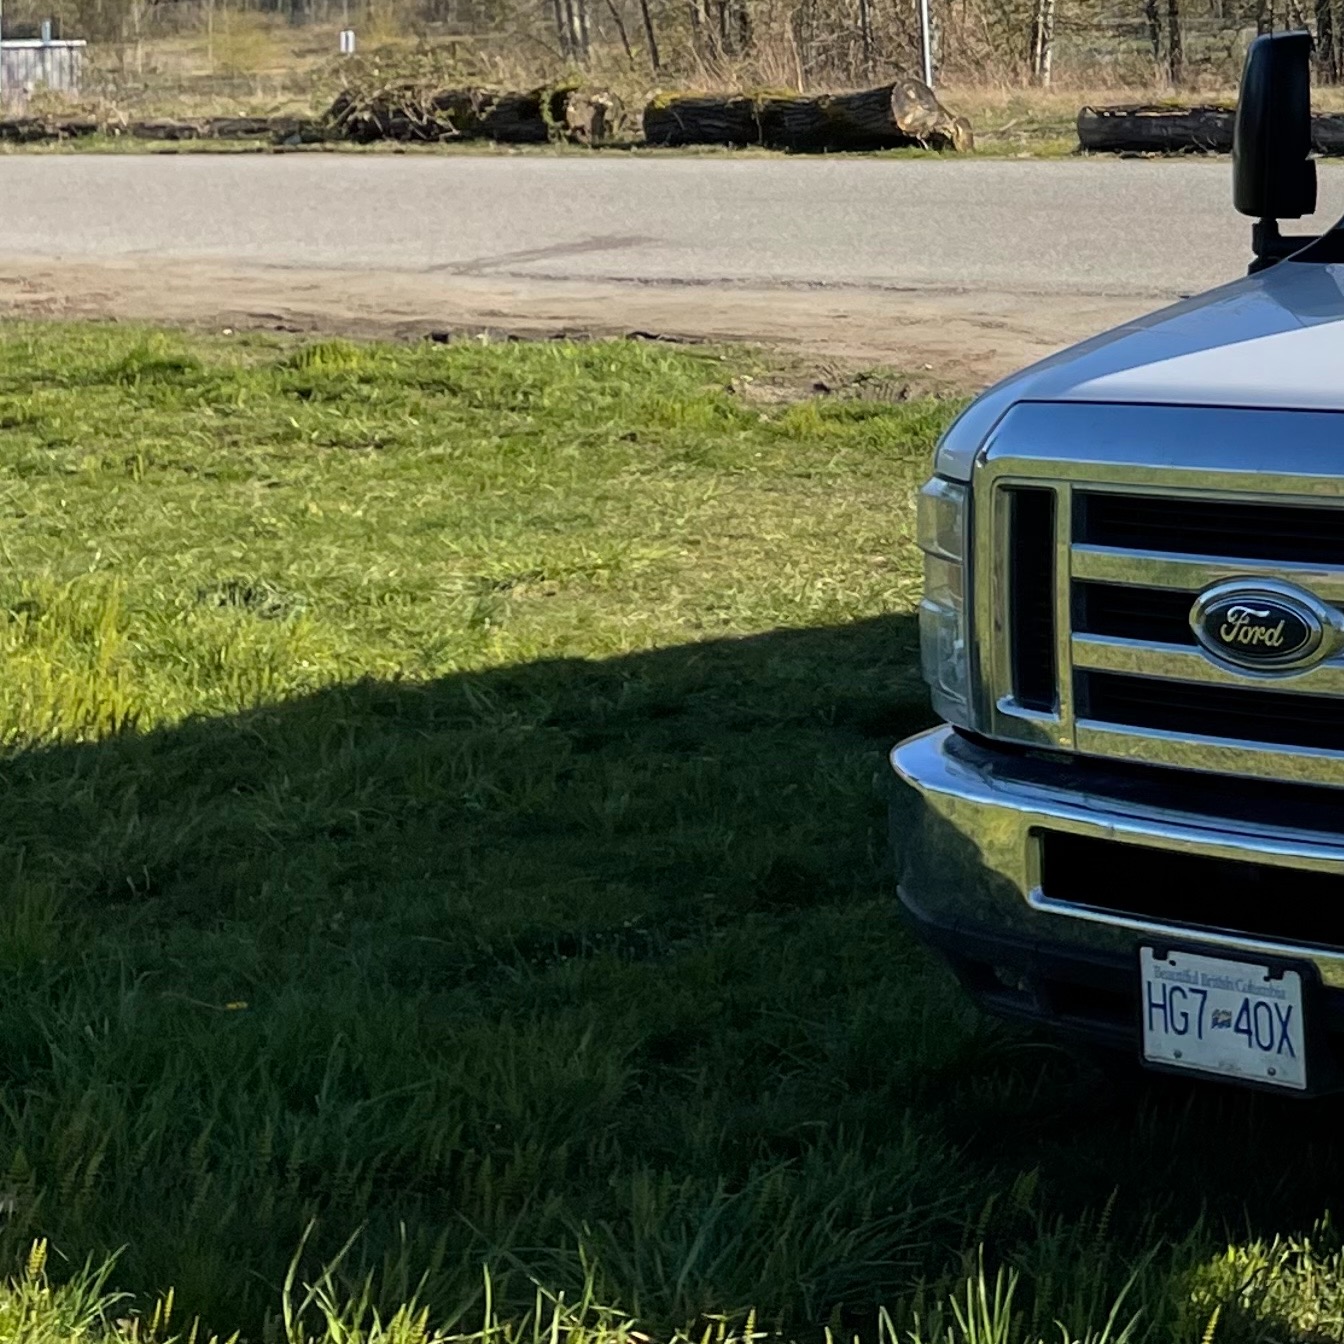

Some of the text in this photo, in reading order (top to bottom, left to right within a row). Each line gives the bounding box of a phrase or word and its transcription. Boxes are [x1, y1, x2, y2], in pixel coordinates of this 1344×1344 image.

[1220, 606, 1286, 647] Ford
[1147, 981, 1297, 1058] HG7 40X
